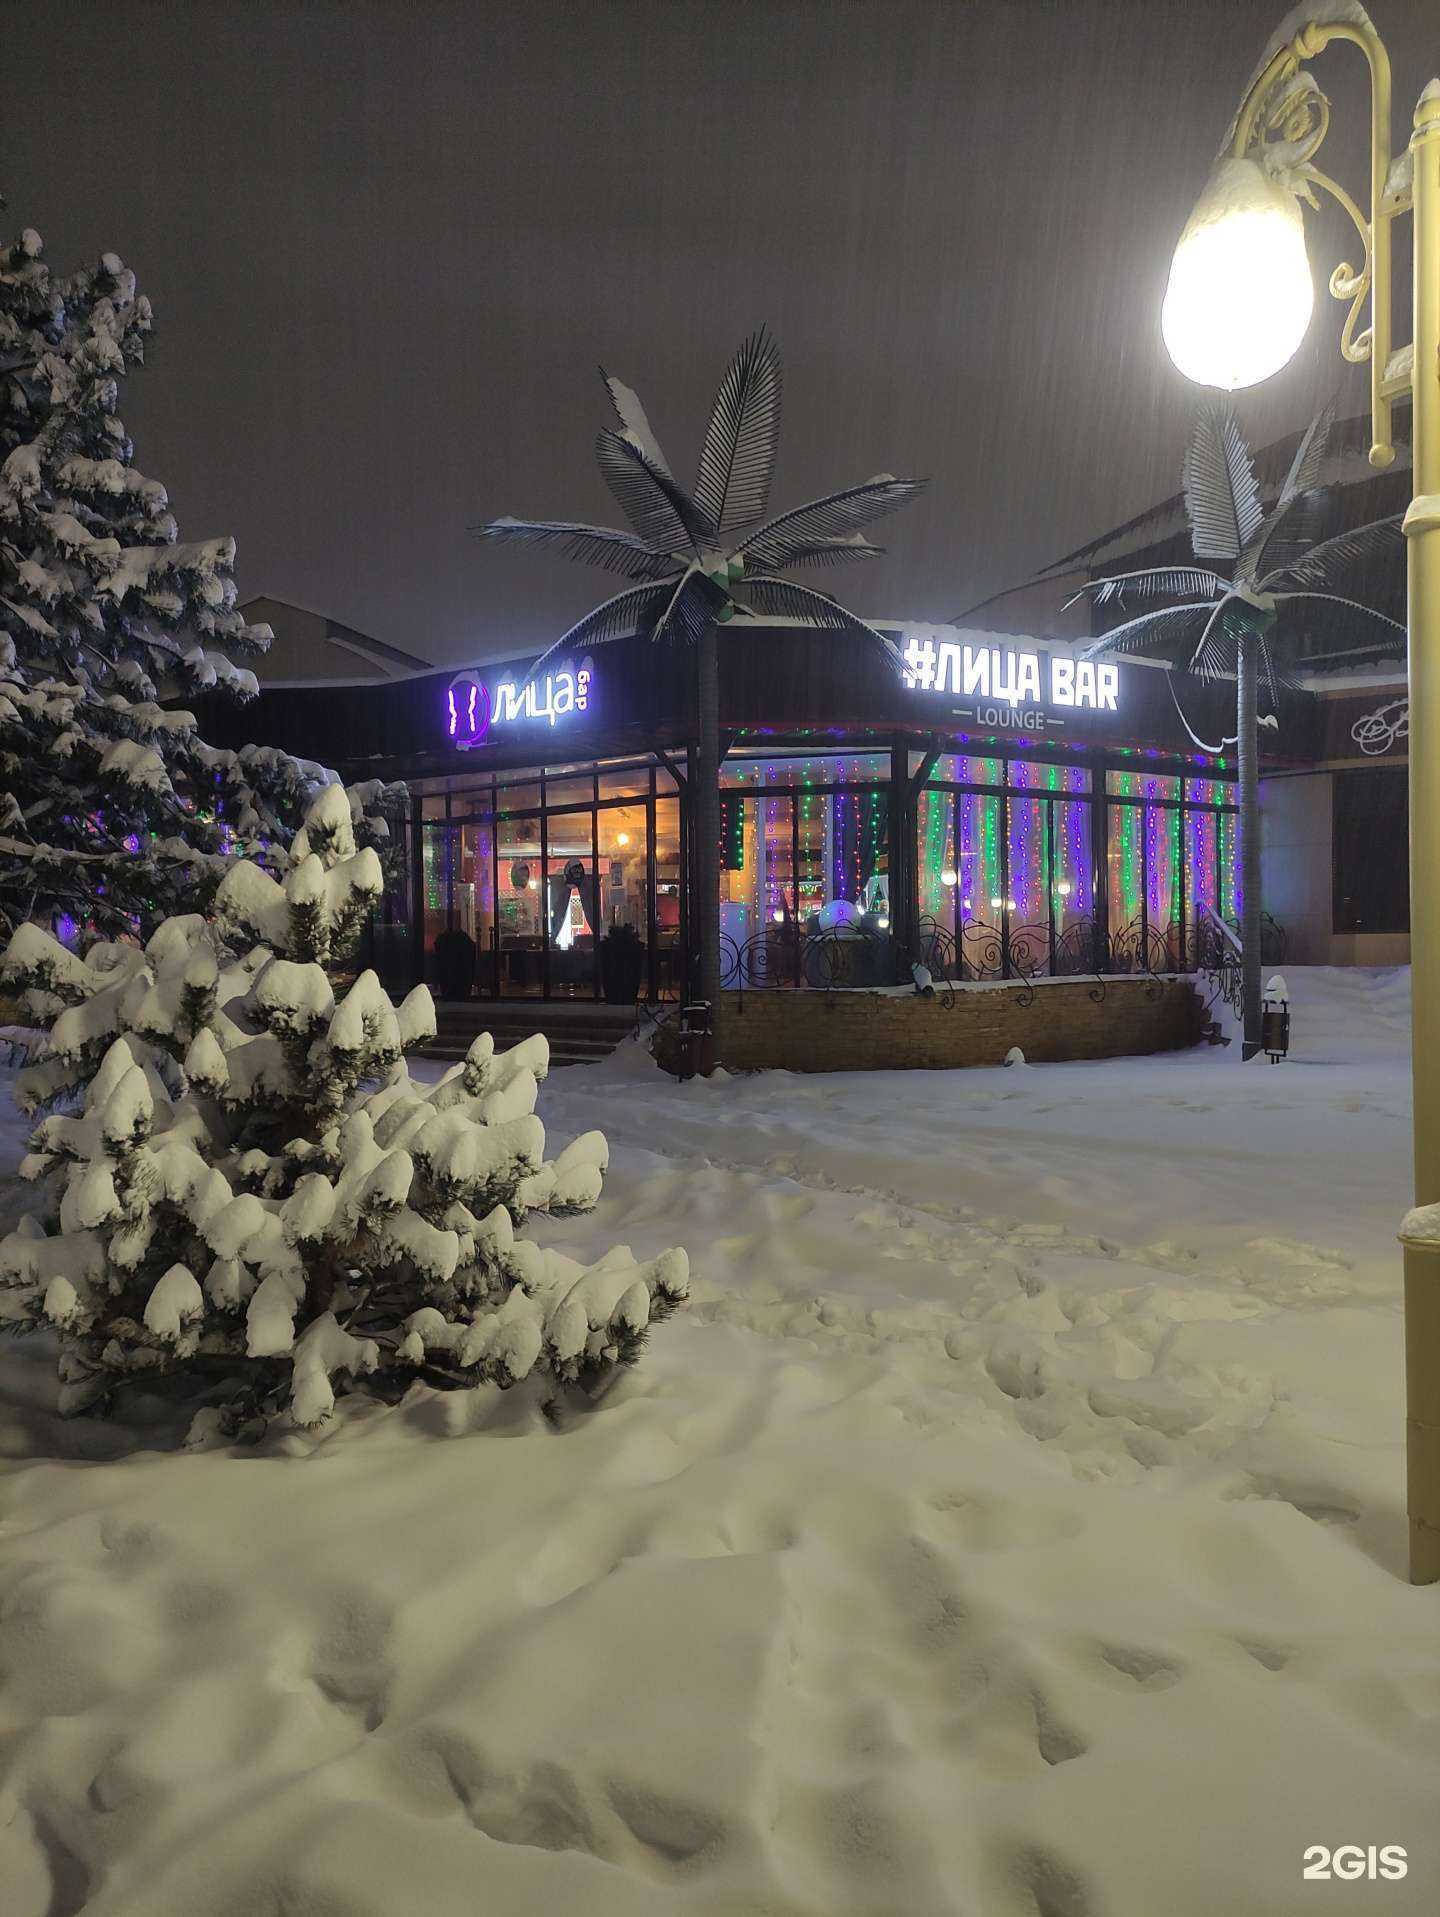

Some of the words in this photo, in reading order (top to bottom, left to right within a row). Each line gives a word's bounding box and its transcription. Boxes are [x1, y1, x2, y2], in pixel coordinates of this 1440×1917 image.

[903, 638, 1041, 708] #ЛИЦА
[1051, 657, 1118, 711] BAR
[976, 706, 1045, 730] LOUNGE
